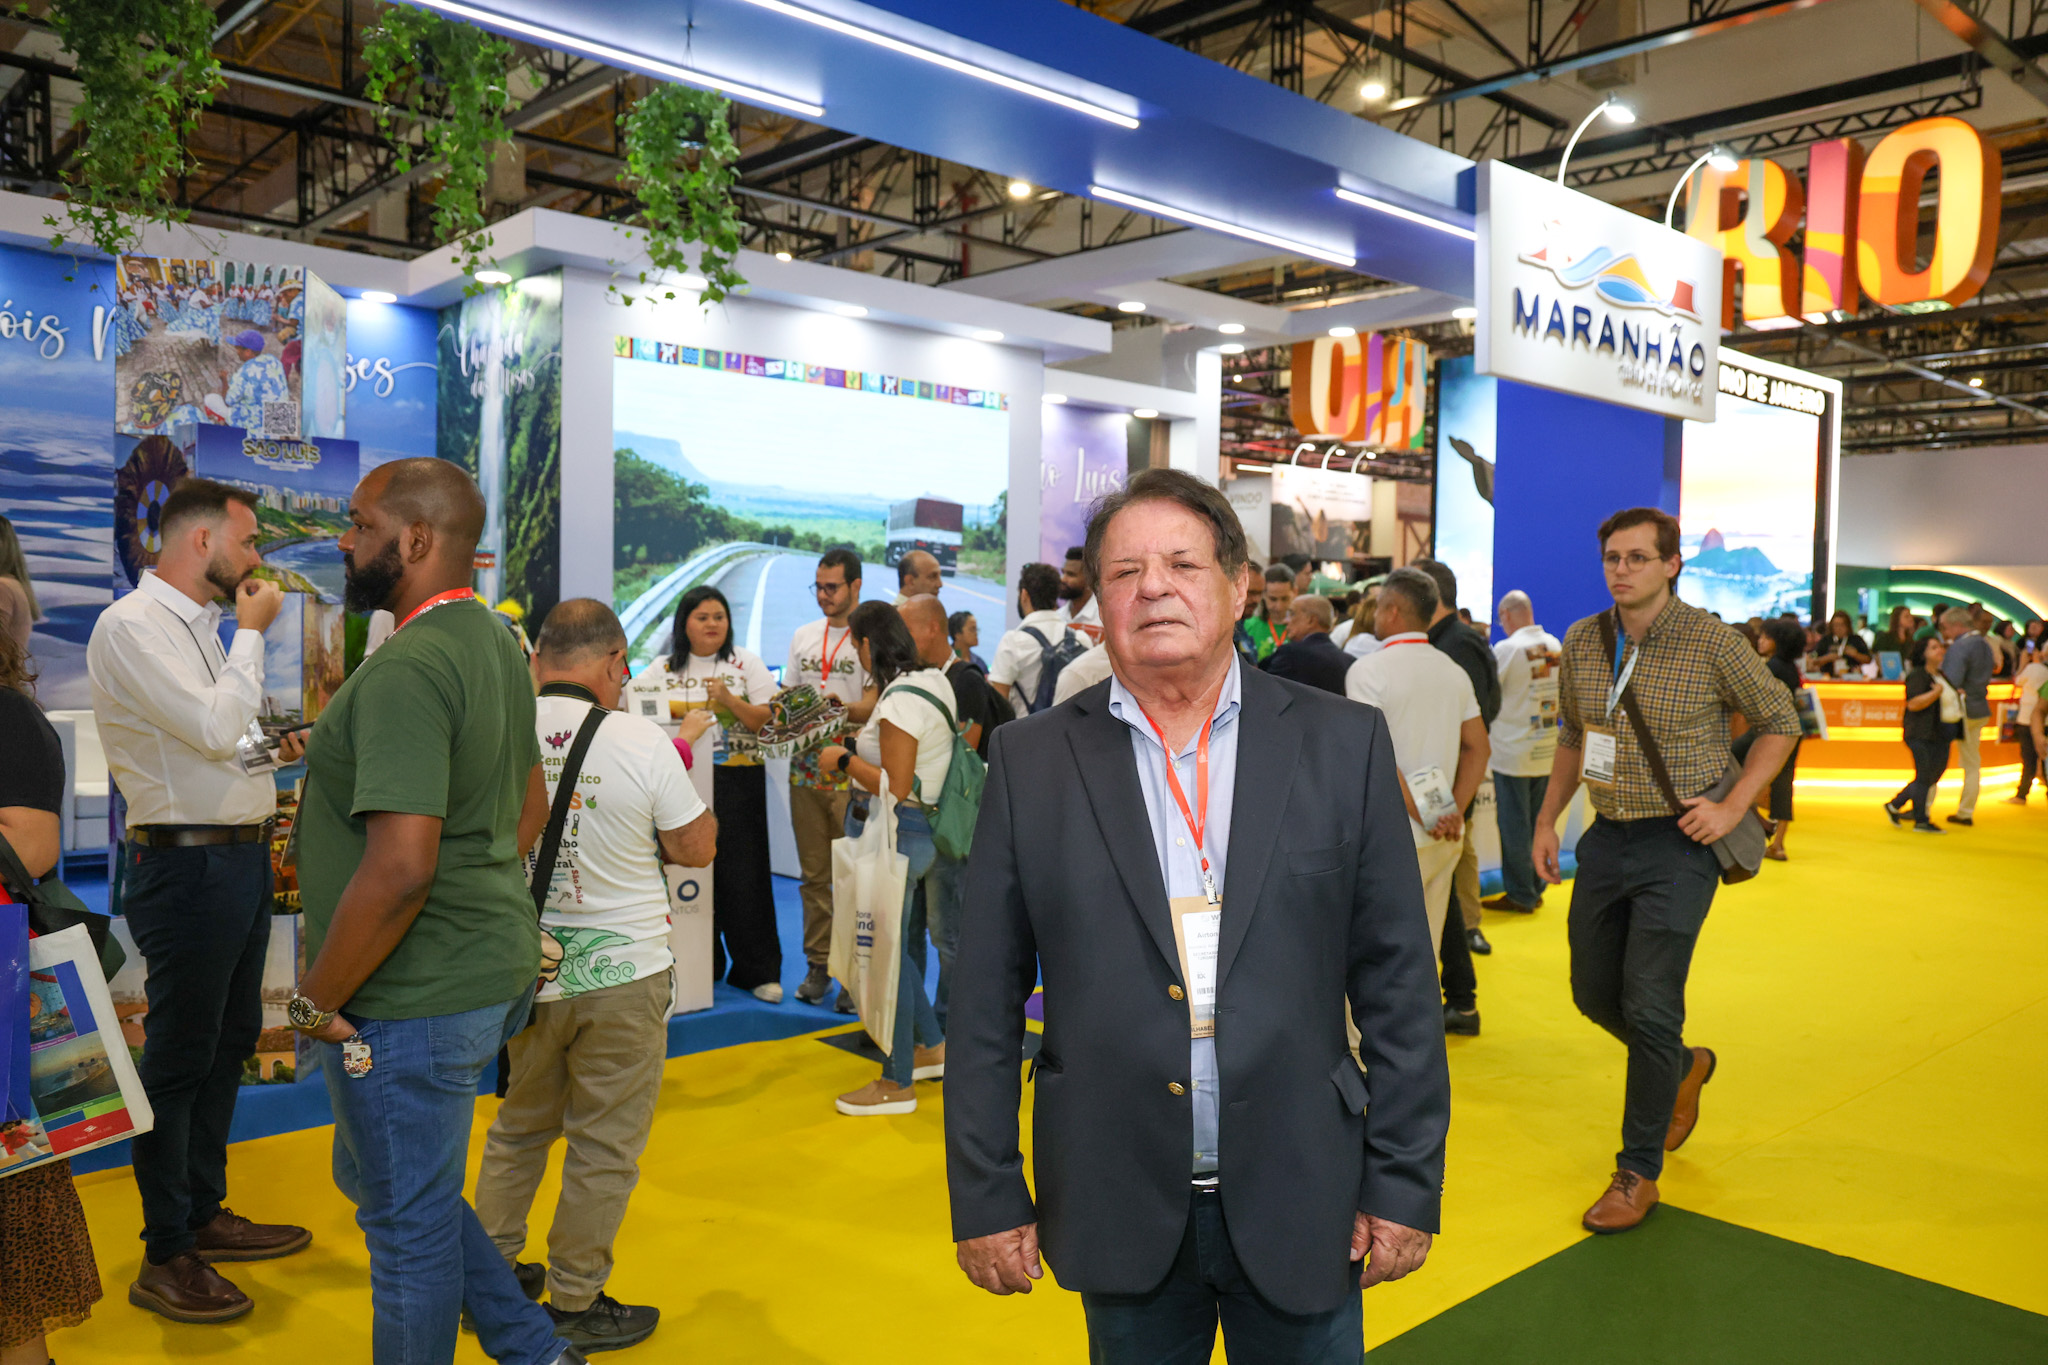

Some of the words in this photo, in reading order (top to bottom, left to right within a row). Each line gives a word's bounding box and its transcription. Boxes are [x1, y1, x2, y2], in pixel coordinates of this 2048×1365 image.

[1687, 116, 2001, 334] RIO
[1514, 287, 1705, 377] MARANHÃO
[1719, 364, 1746, 397] RIO
[1746, 373, 1769, 403] DE
[1768, 379, 1826, 416] JANEIRO
